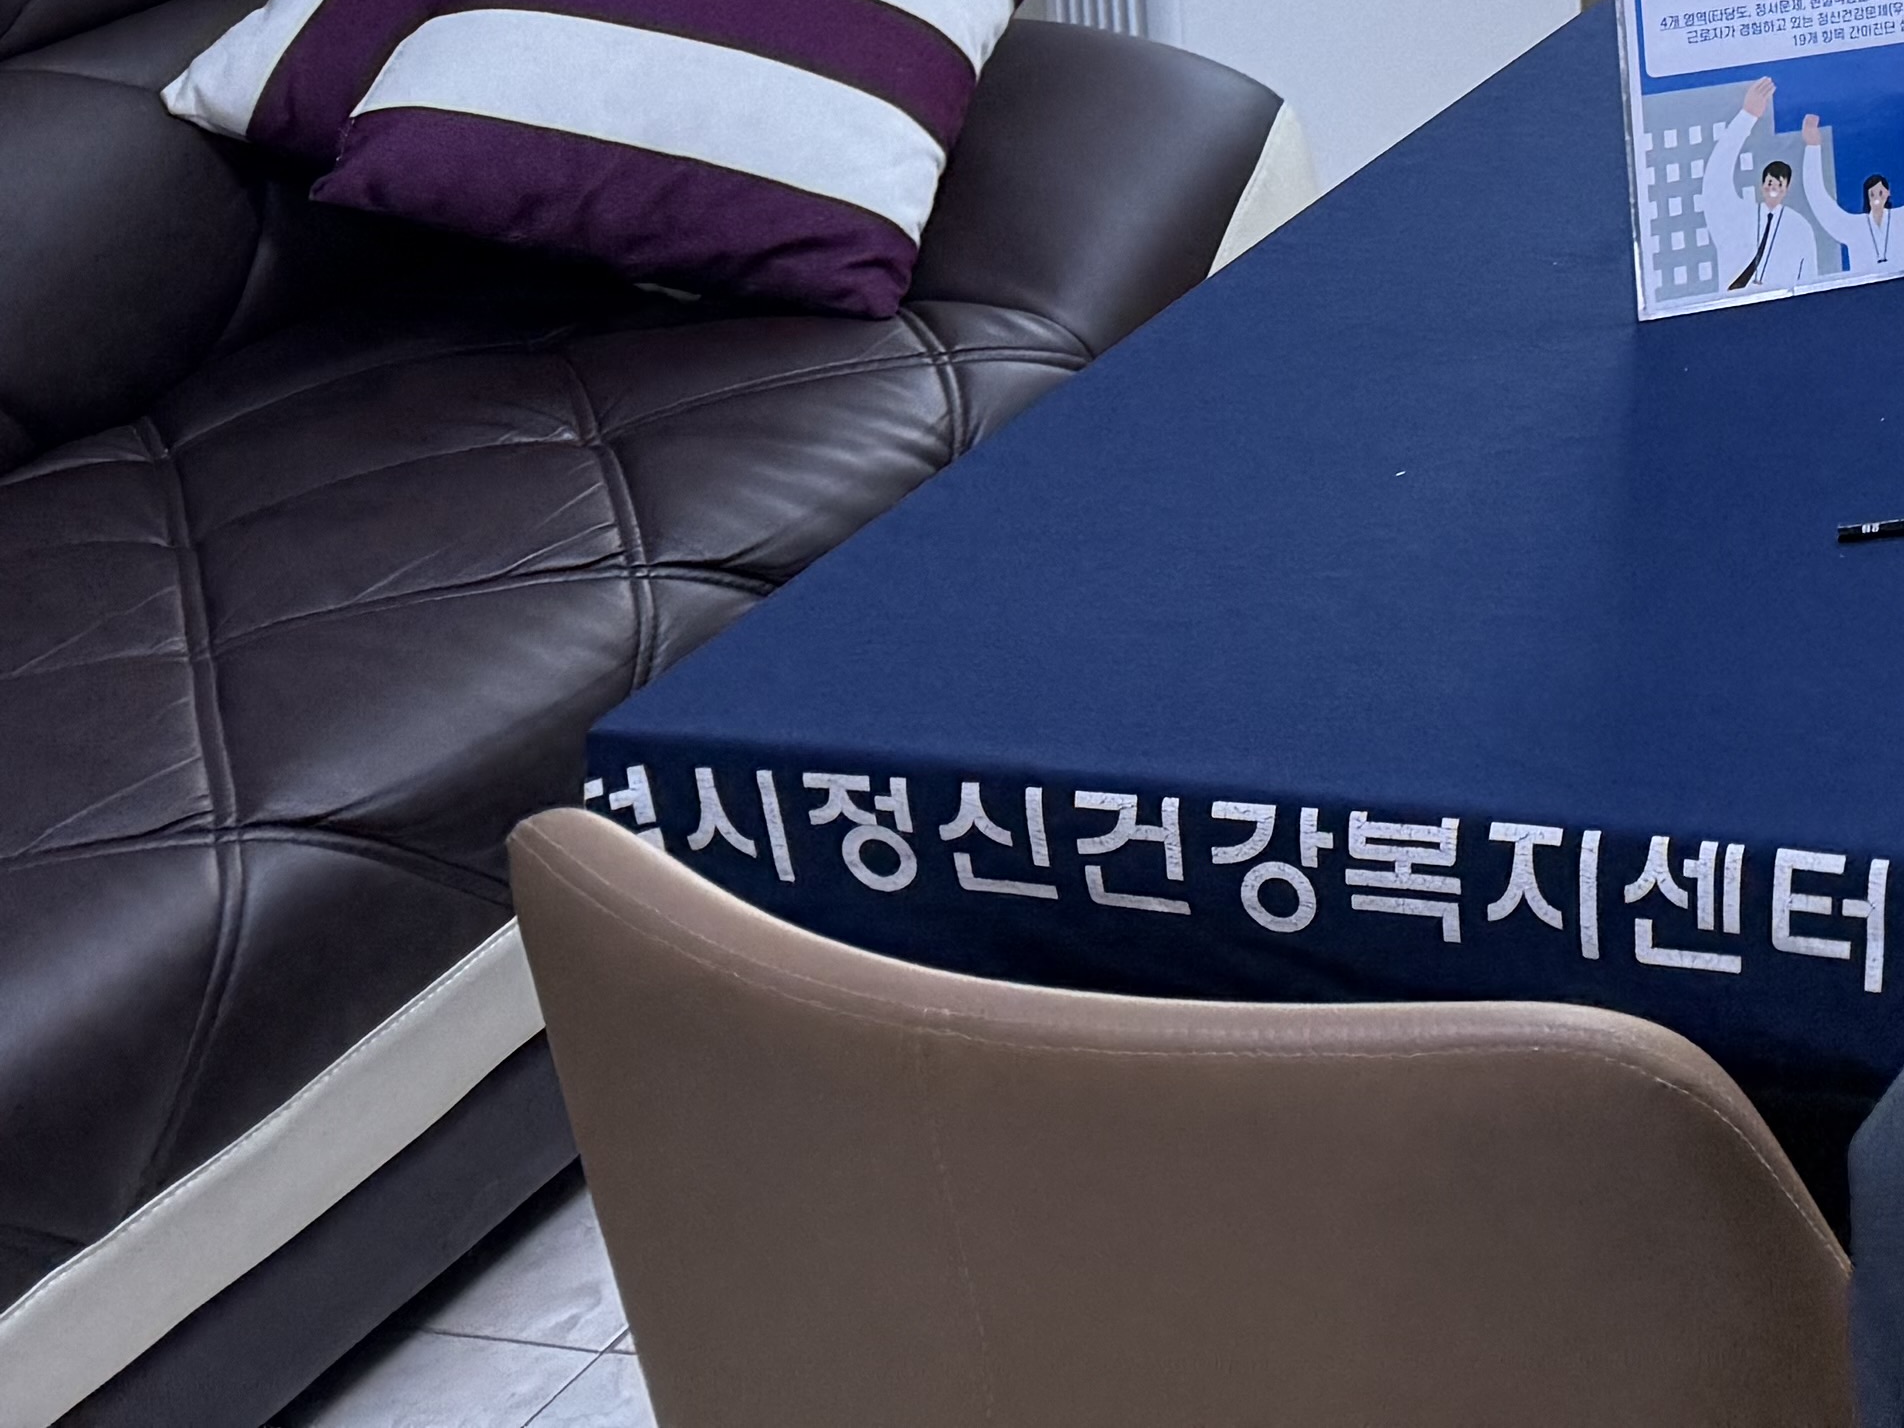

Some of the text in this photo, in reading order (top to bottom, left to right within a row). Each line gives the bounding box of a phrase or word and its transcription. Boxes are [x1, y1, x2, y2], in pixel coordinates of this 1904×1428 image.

[1686, 25, 1737, 45] 근로자가
[1739, 17, 1788, 37] 경험하고
[1791, 14, 1814, 30] 있는
[1793, 31, 1819, 47] 19개
[1849, 21, 1896, 41] 간이진단
